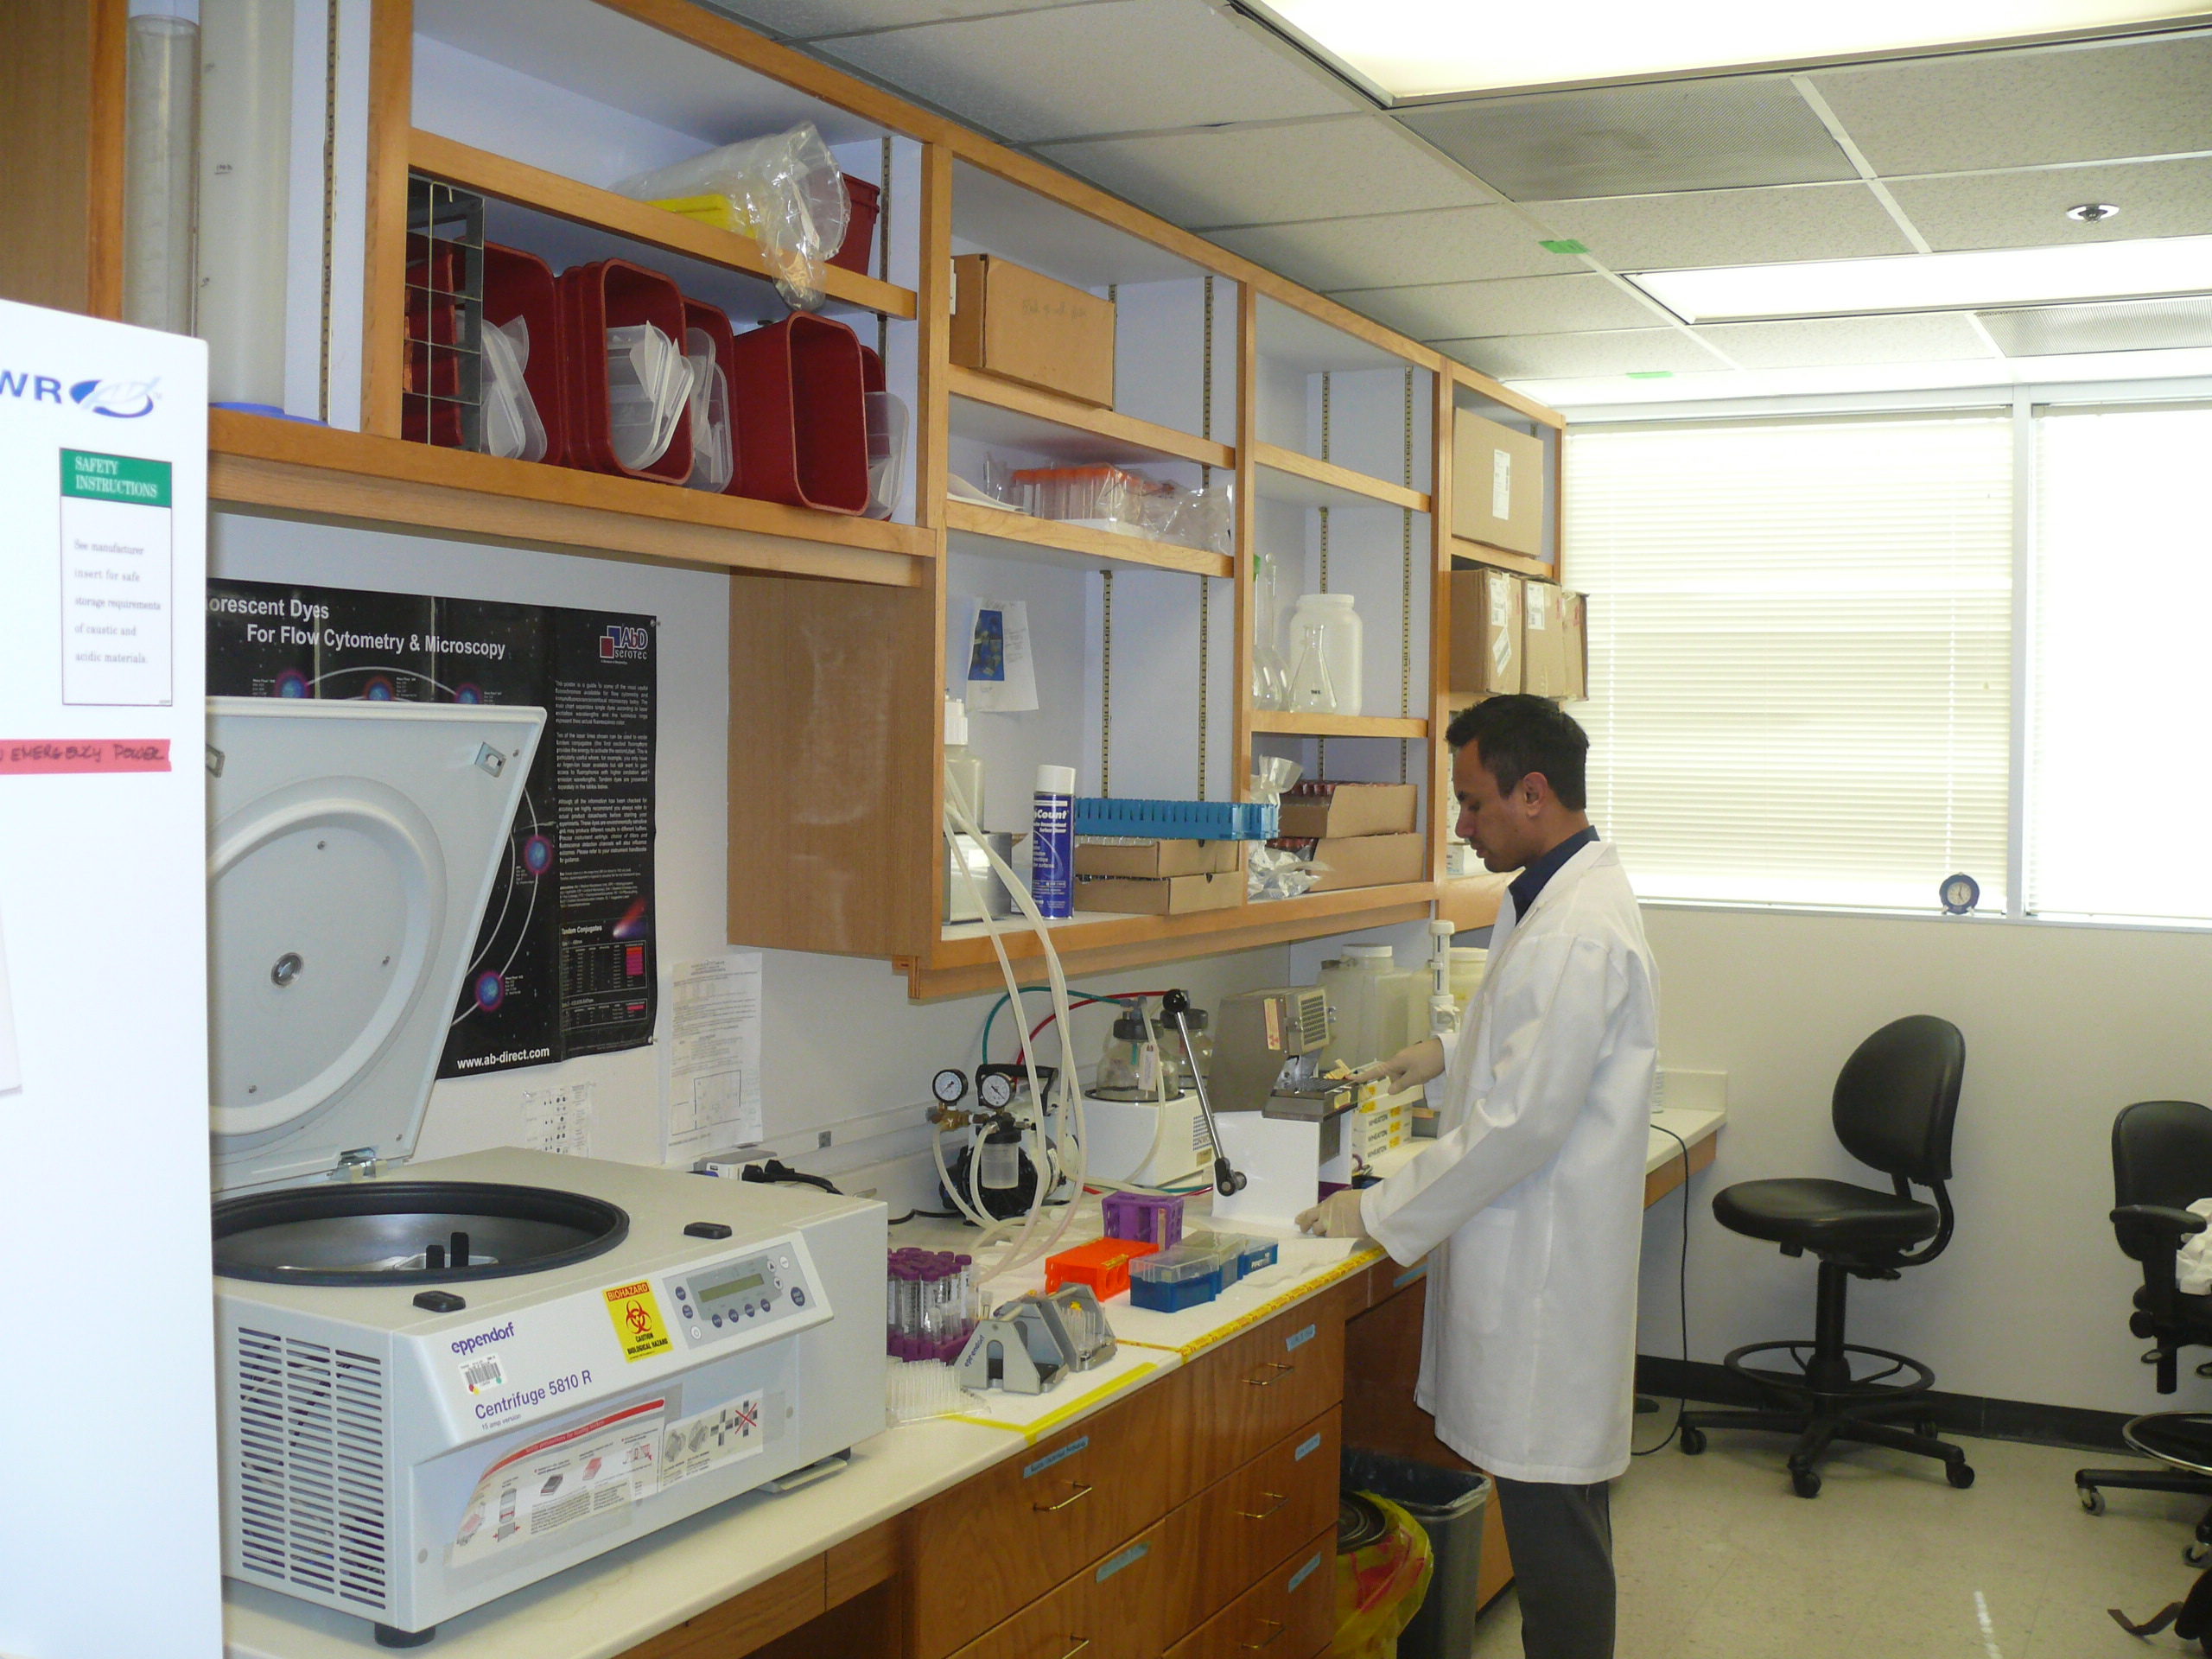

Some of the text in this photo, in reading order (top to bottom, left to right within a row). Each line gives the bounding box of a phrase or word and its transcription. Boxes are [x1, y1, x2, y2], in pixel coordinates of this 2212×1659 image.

[74, 455, 118, 475] SAFETY
[75, 474, 158, 499] INSTRUCTIONS
[73, 539, 145, 556] See manufacturer
[73, 569, 141, 583] insert for safe
[74, 596, 105, 609] storage
[207, 597, 330, 623] orescent Dyes
[74, 623, 137, 638] of caustic and
[620, 626, 648, 650] AbD
[246, 623, 506, 660] For Flow Cytometry & Microscopy
[75, 651, 102, 664] acidic
[112, 742, 165, 761] POWER
[576, 925, 603, 934] Conjugates
[456, 1047, 550, 1070] www.ab-direct.com
[1368, 1114, 1389, 1127] WHEATON
[1367, 1129, 1388, 1142] WHEATON
[1367, 1145, 1387, 1159] WHEATON
[607, 1283, 648, 1301] BIOHAZARD
[451, 1321, 515, 1357] eppendorf
[635, 1332, 654, 1343] CAUTION
[626, 1343, 652, 1355] BIOLOGICAL
[652, 1338, 669, 1348] HAZARD
[474, 1370, 593, 1420] Centrifuge 5810 R
[489, 1420, 501, 1429] amp
[502, 1414, 522, 1425] version
